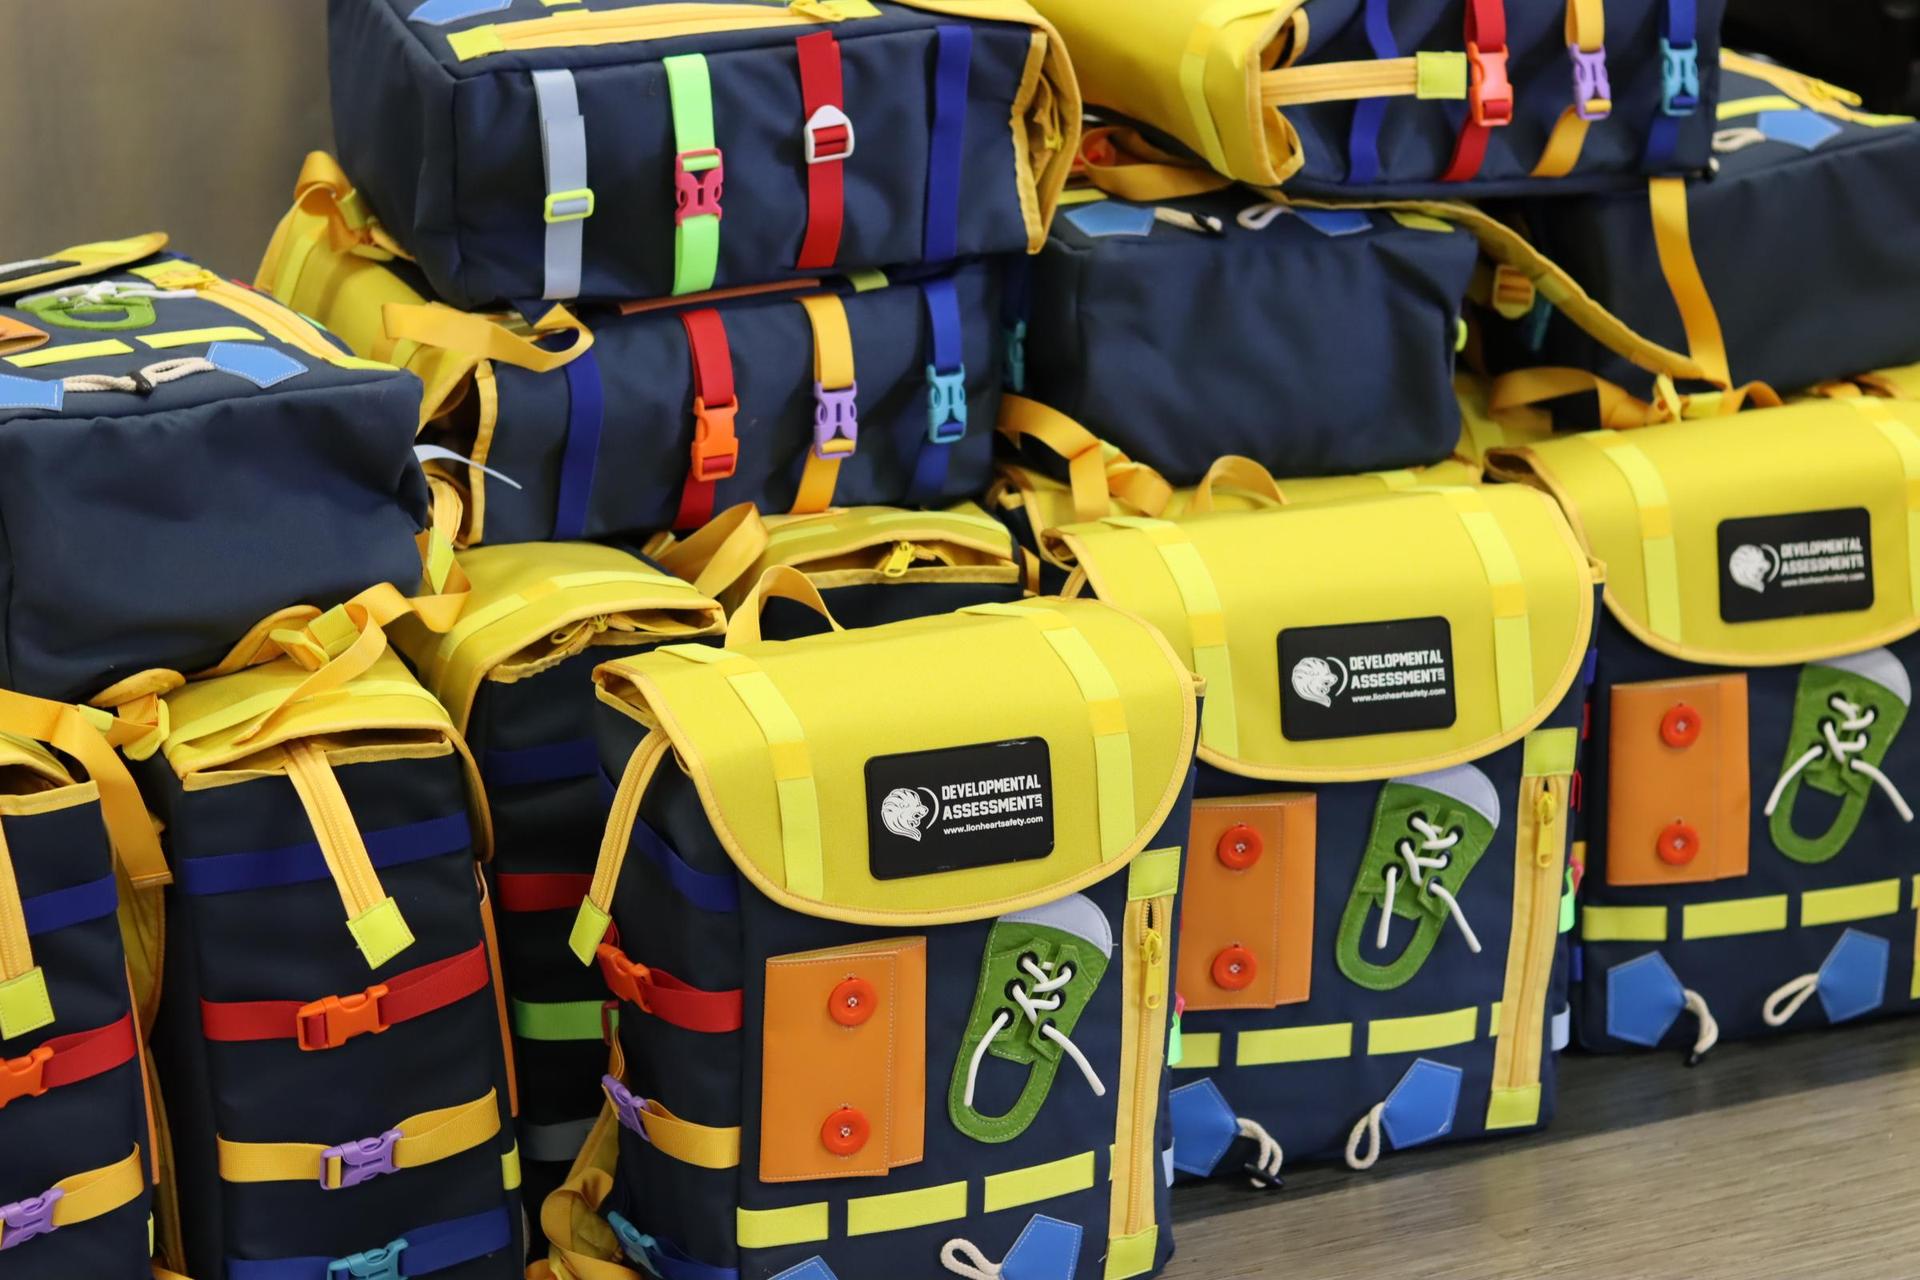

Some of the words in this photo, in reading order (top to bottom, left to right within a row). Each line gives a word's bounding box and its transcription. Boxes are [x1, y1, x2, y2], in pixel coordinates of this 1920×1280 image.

[1349, 649, 1443, 671] DEVELOPMENTAL
[1351, 668, 1437, 689] ASSESSMENT
[941, 774, 1041, 800] DEVELOPMENTAL
[942, 795, 1034, 820] ASSESSMENT
[943, 815, 1043, 835] www.lionheartsafety.com
